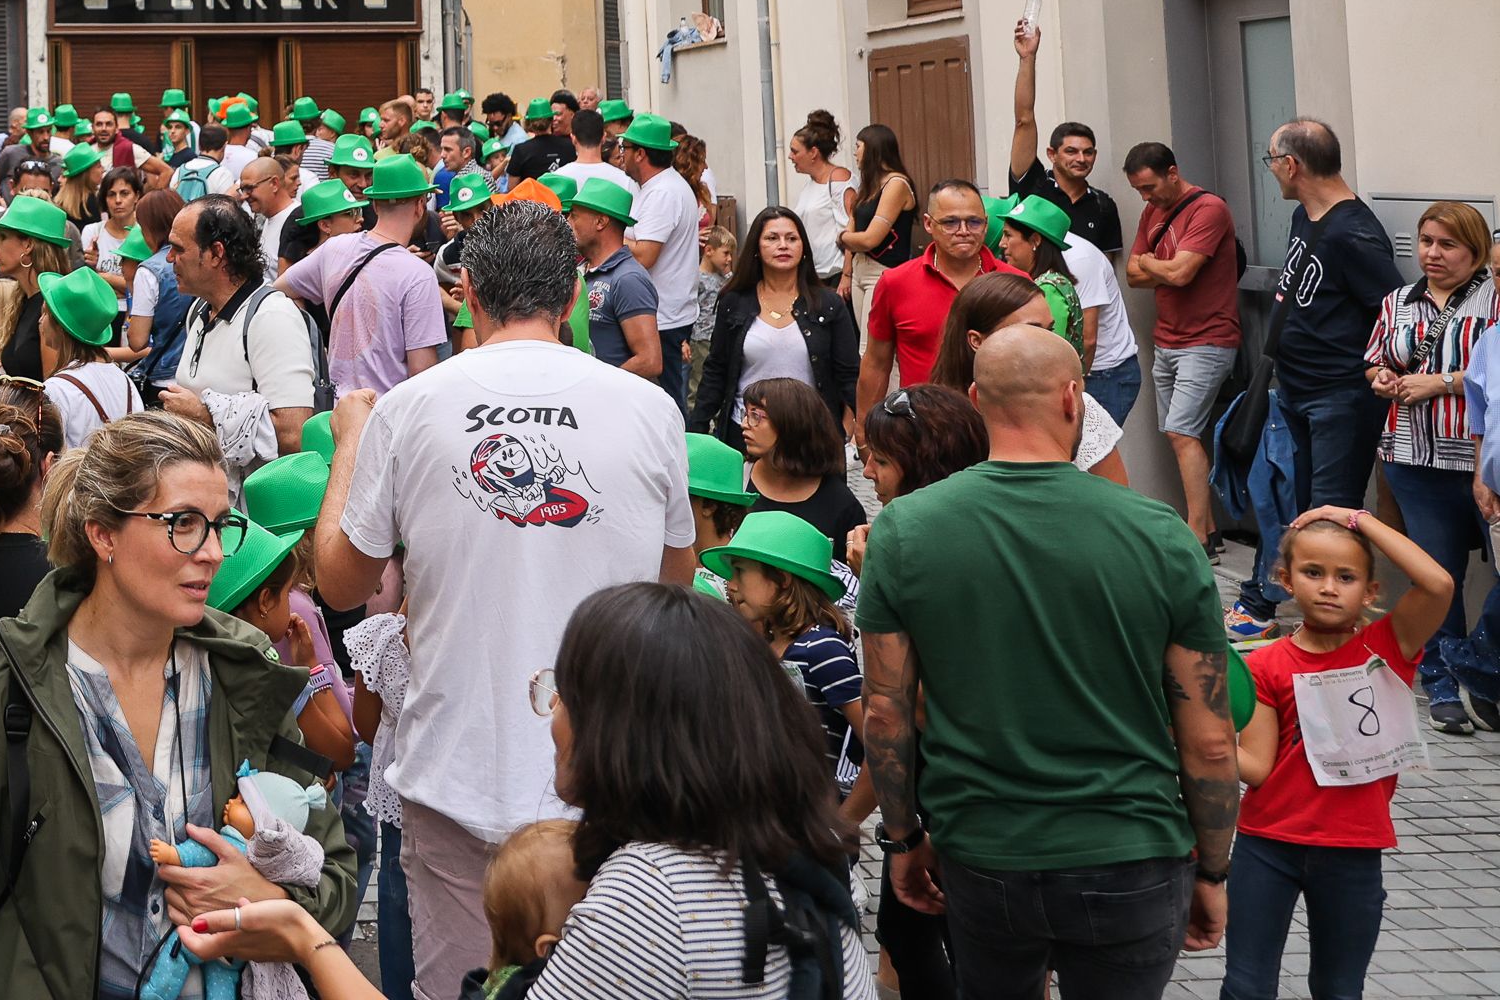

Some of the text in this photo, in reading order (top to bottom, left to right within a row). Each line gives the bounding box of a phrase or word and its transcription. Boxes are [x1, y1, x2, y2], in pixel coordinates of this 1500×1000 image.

[1428, 305, 1456, 338] FROEVER
[1413, 340, 1432, 361] LOVE
[465, 404, 579, 432] SCOTTA
[540, 503, 567, 518] 1985
[1348, 685, 1380, 737] 8
